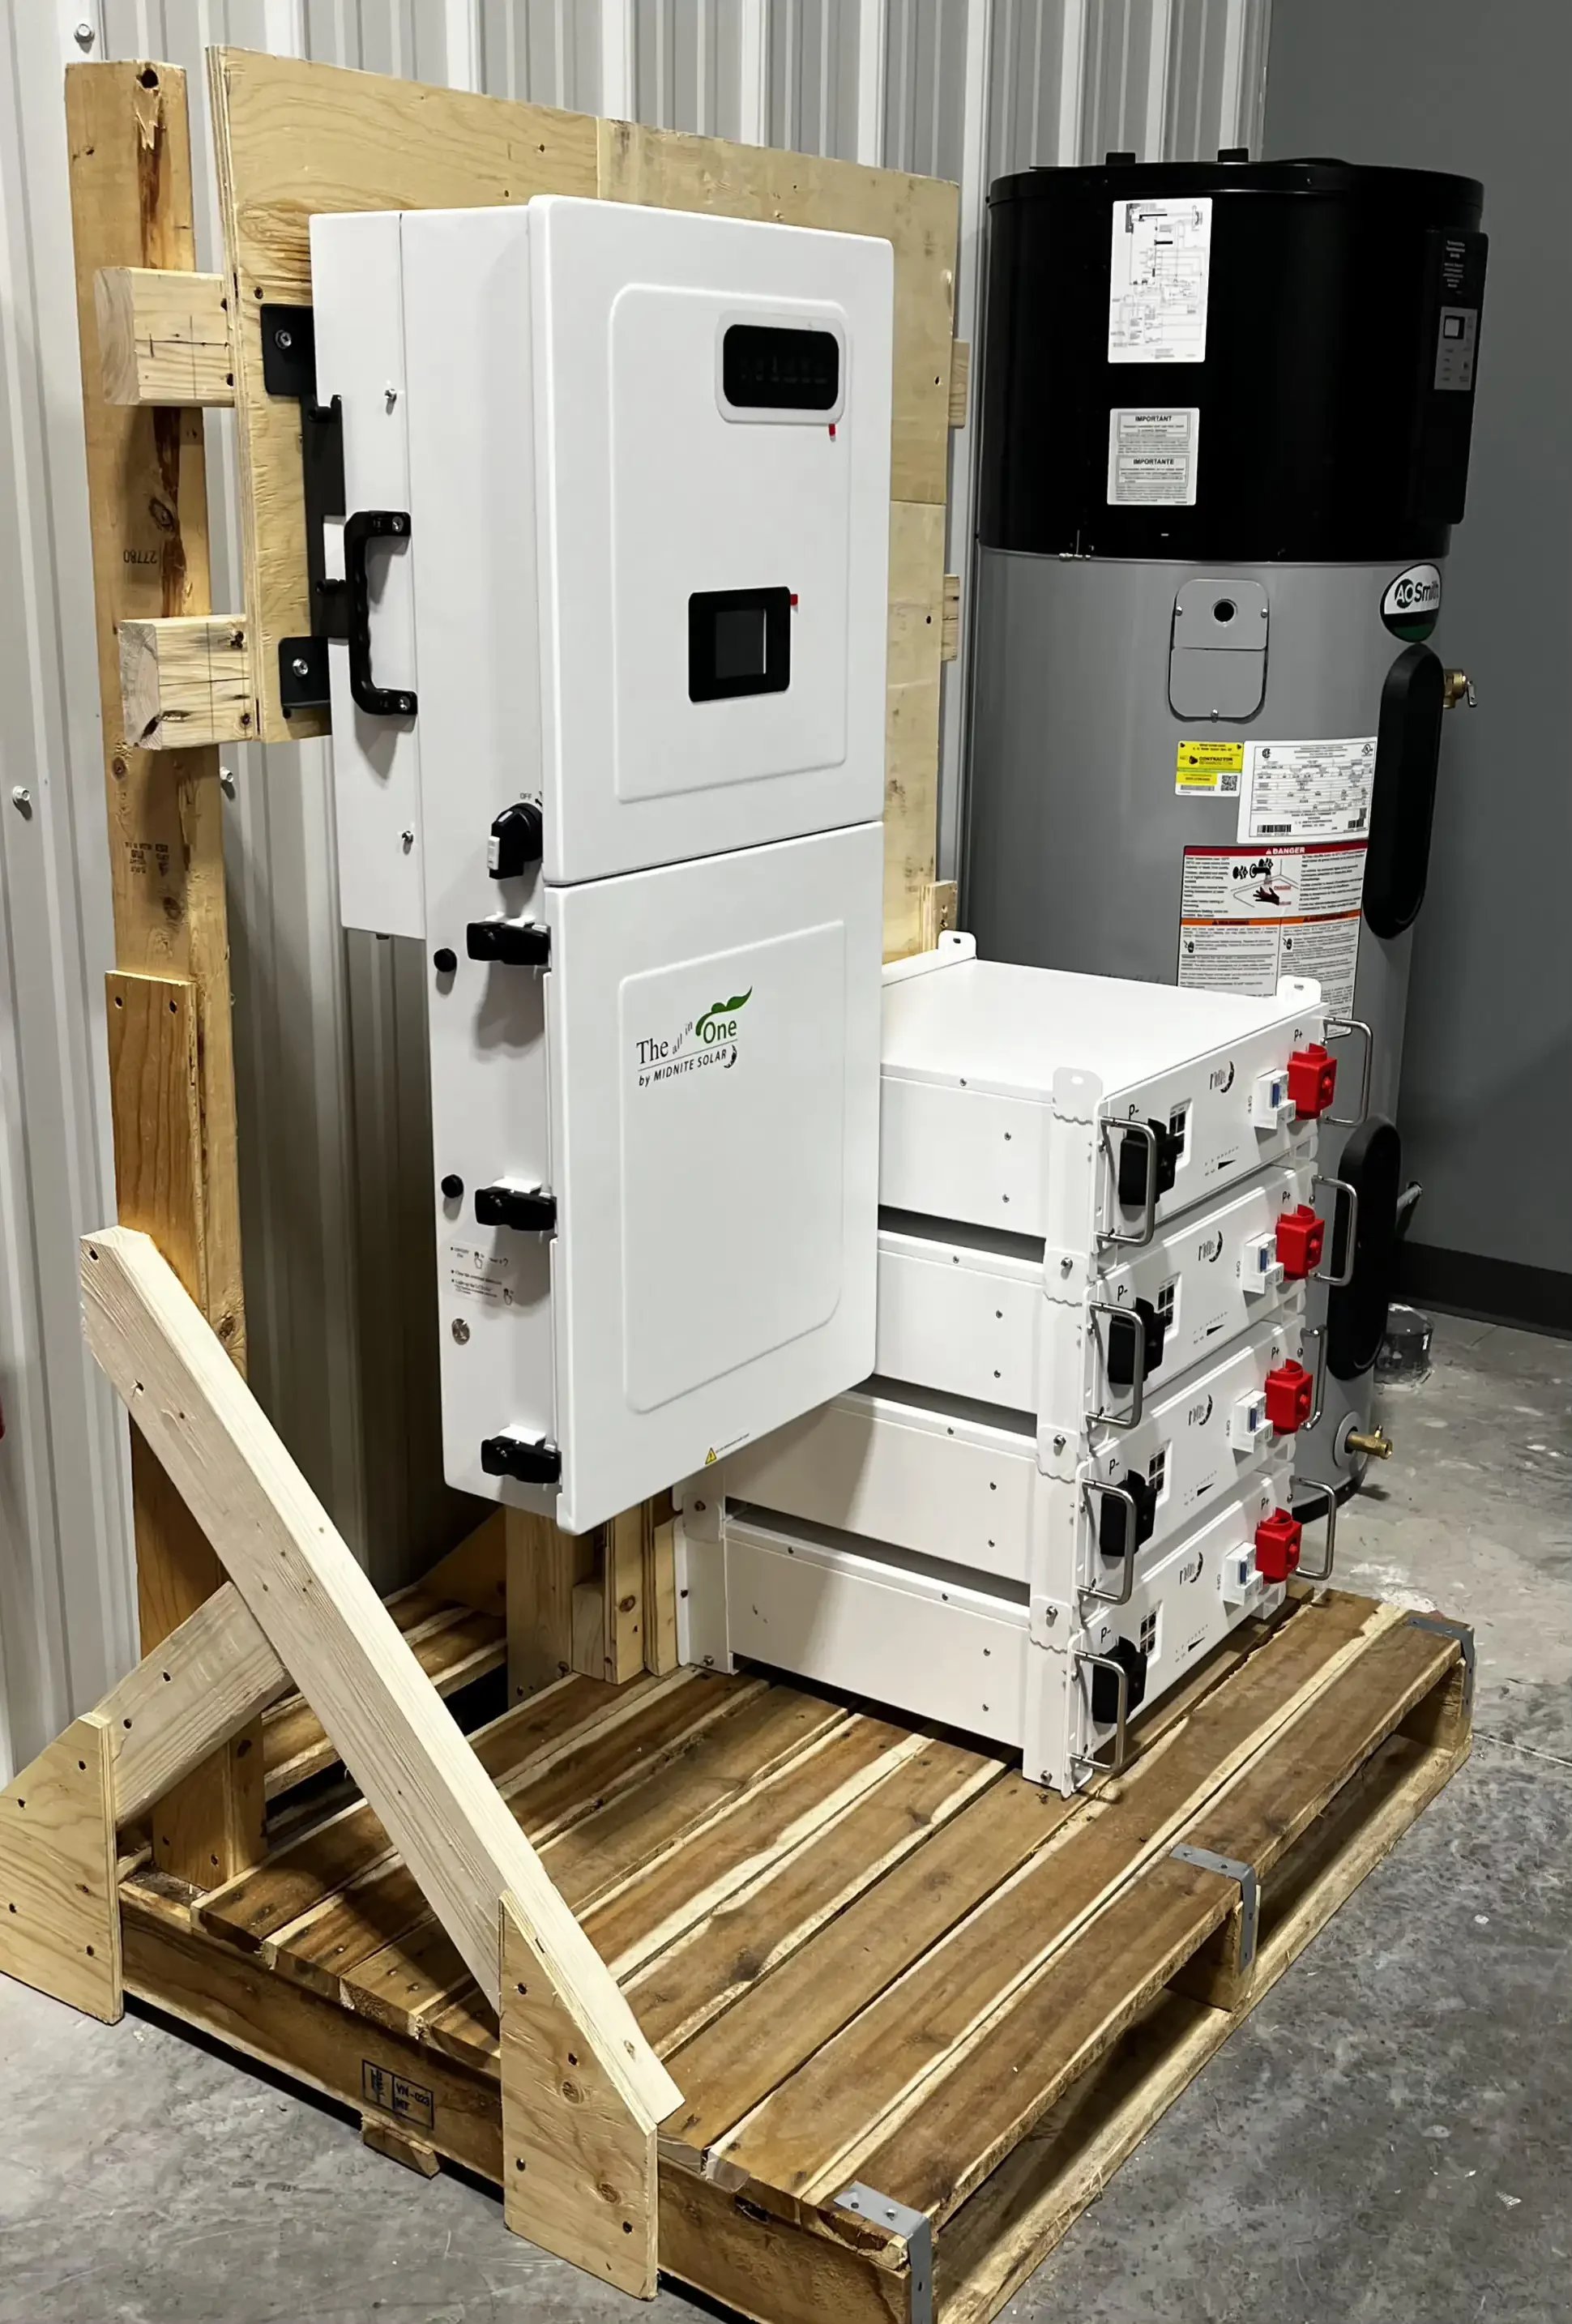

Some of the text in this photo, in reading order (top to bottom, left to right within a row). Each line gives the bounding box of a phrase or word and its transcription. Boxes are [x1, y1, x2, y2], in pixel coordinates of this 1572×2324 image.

[123, 549, 157, 564] 27780
[1272, 846, 1305, 855] DANGER
[636, 1038, 669, 1064] The
[703, 1020, 737, 1044] One
[639, 1049, 727, 1087] by MIDNITE SOLAR
